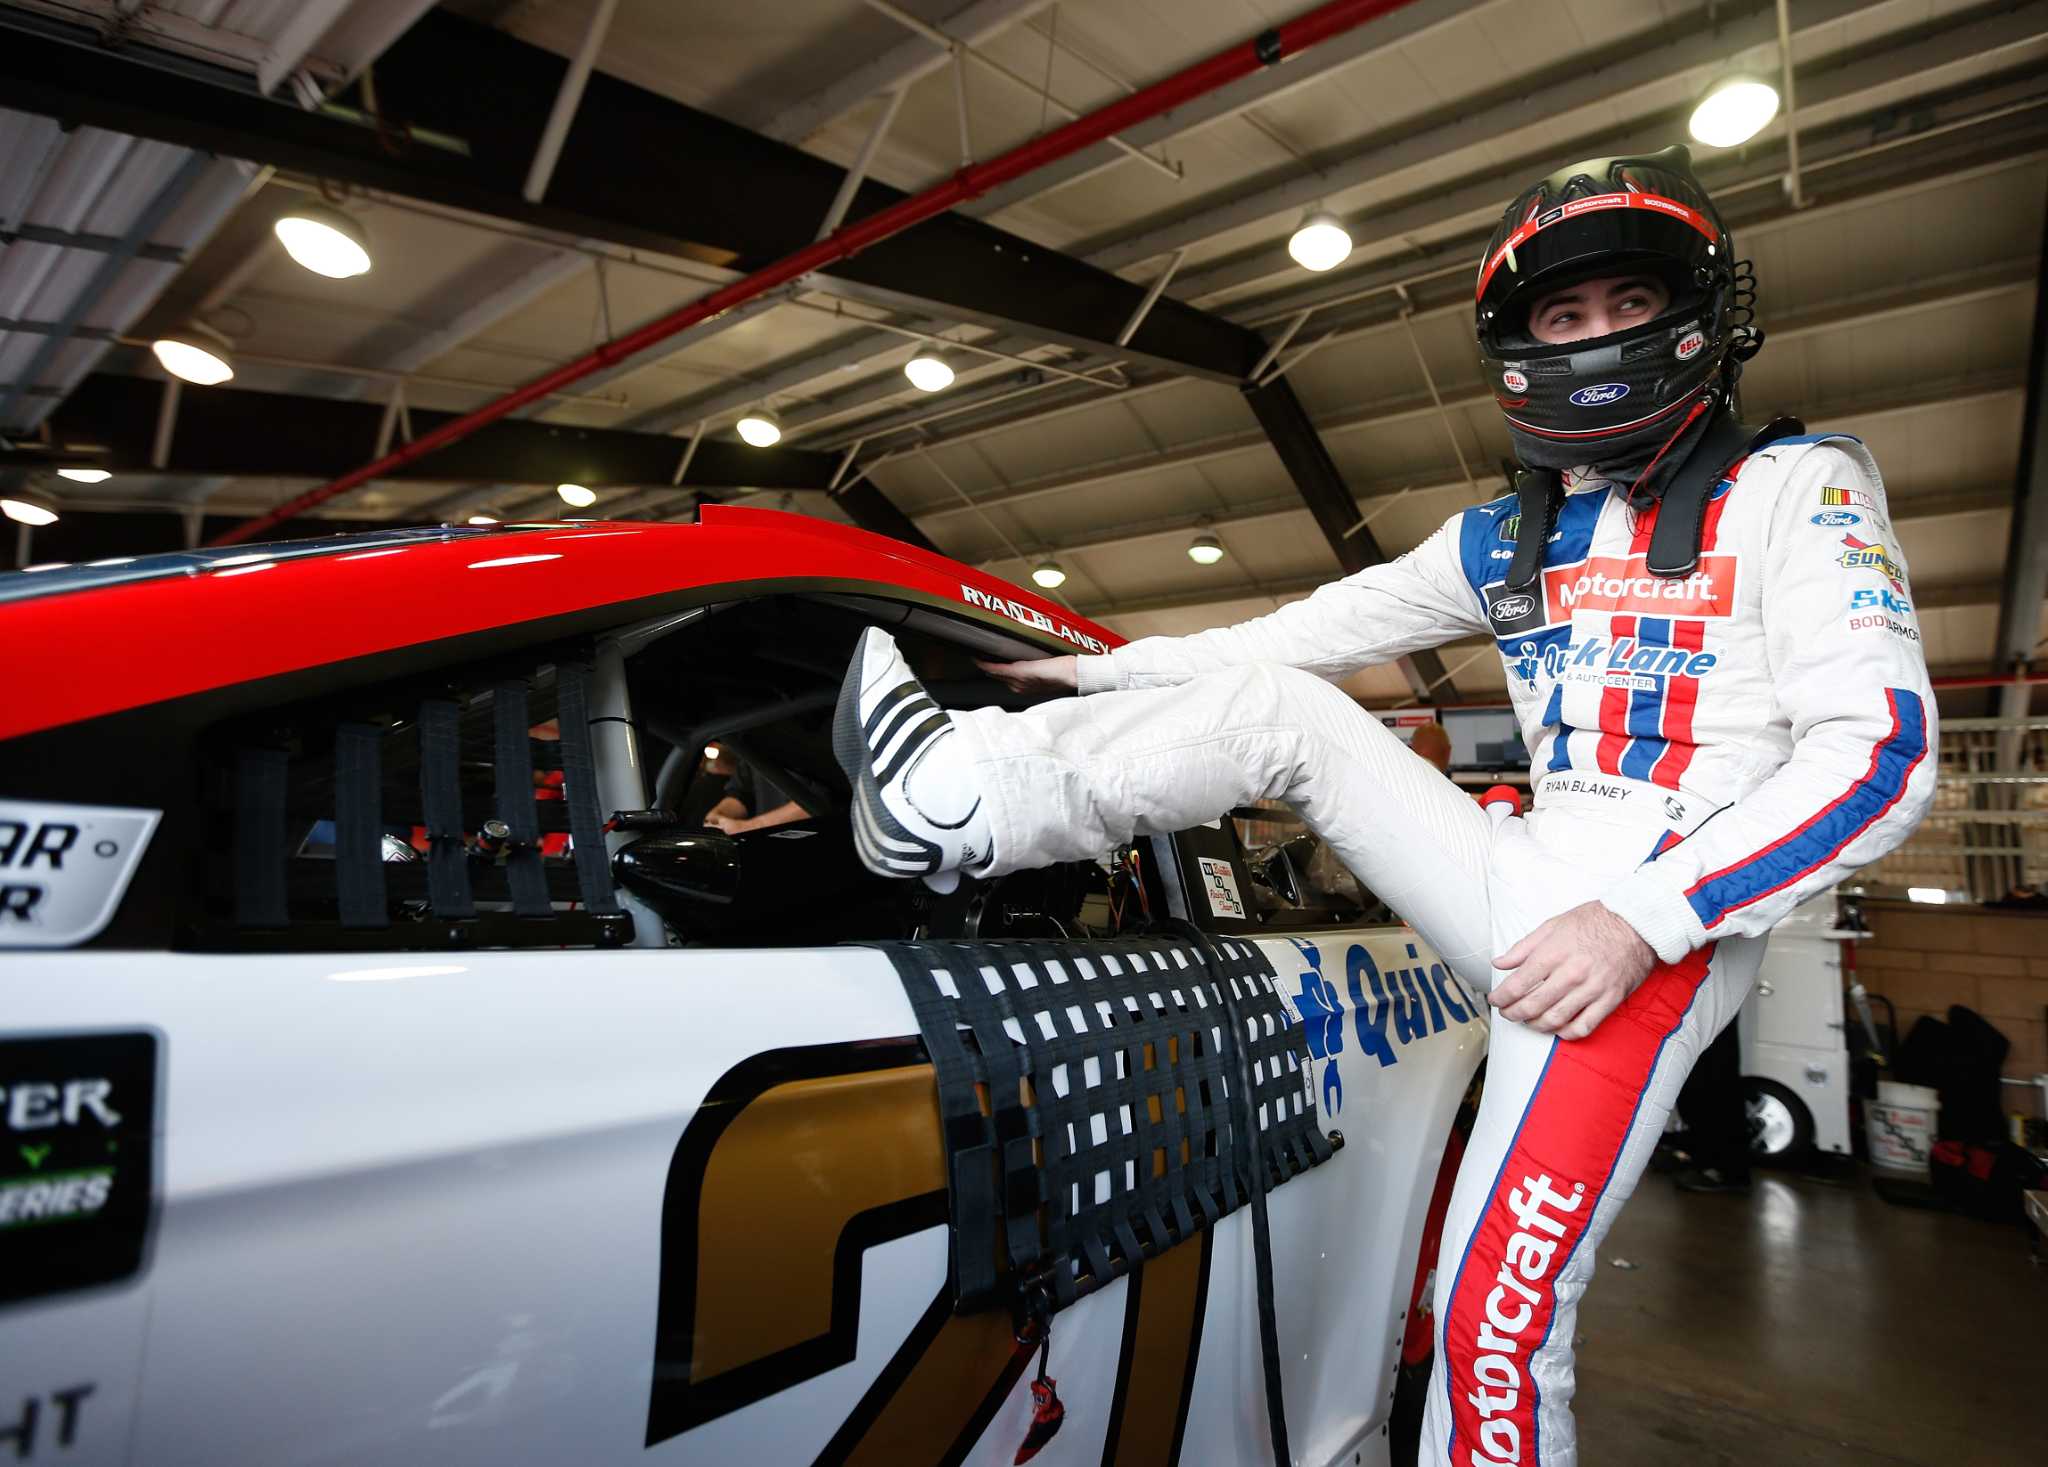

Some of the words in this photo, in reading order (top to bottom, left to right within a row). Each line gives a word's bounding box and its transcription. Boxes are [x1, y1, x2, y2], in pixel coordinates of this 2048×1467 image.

[1679, 335, 1702, 354] BELL
[1505, 375, 1525, 386] BELL
[1580, 386, 1618, 404] Ford
[1846, 552, 1904, 581] SUNCO
[960, 584, 1024, 621] RYAN
[1495, 599, 1529, 619] Ford
[1851, 588, 1911, 616] SKF
[1543, 638, 1607, 680] Quk
[1607, 639, 1718, 676] Lane
[1545, 780, 1570, 793] RYAN
[1571, 780, 1632, 800] BLANEY
[1346, 943, 1480, 1067] Quic
[0, 1078, 121, 1130] ER
